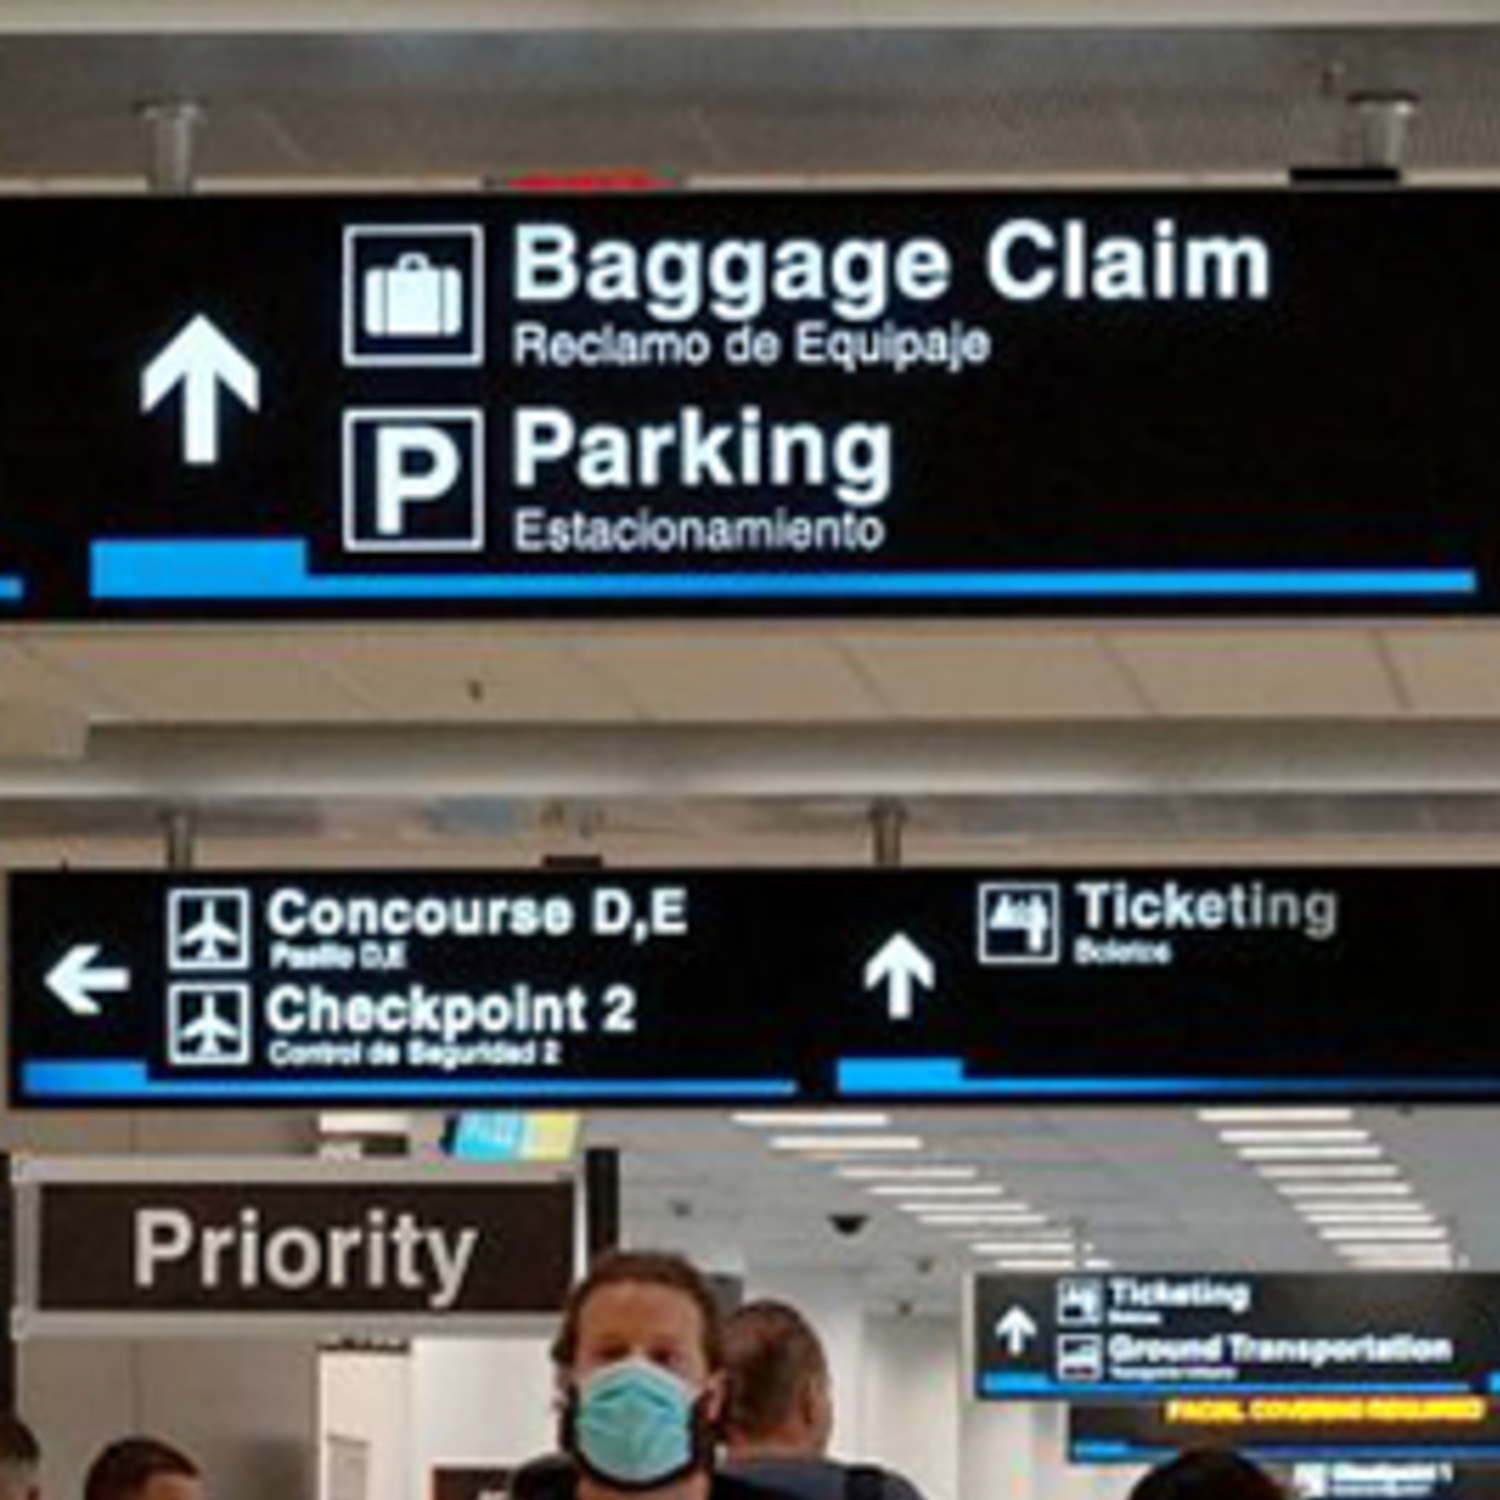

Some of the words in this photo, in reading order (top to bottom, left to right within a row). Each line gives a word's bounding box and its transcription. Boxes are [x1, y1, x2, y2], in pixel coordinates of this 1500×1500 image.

[515, 223, 950, 317] Baggage
[987, 219, 1268, 302] Claim
[514, 321, 711, 366] Reclamo
[726, 321, 781, 365] de
[795, 321, 991, 371] Equipaje
[515, 406, 890, 503] Parking
[514, 510, 885, 552] Estacionamiento
[267, 888, 574, 937] Concourse
[593, 888, 687, 942] D,E
[1075, 881, 1336, 938] Ticketing
[265, 984, 586, 1041] Checkpoint
[603, 985, 636, 1032] 2
[367, 1041, 400, 1065] de
[136, 1208, 477, 1307] Priority
[1107, 1278, 1250, 1313] Ticketing
[1108, 1334, 1222, 1363] Ground
[1229, 1334, 1453, 1366] Transportation
